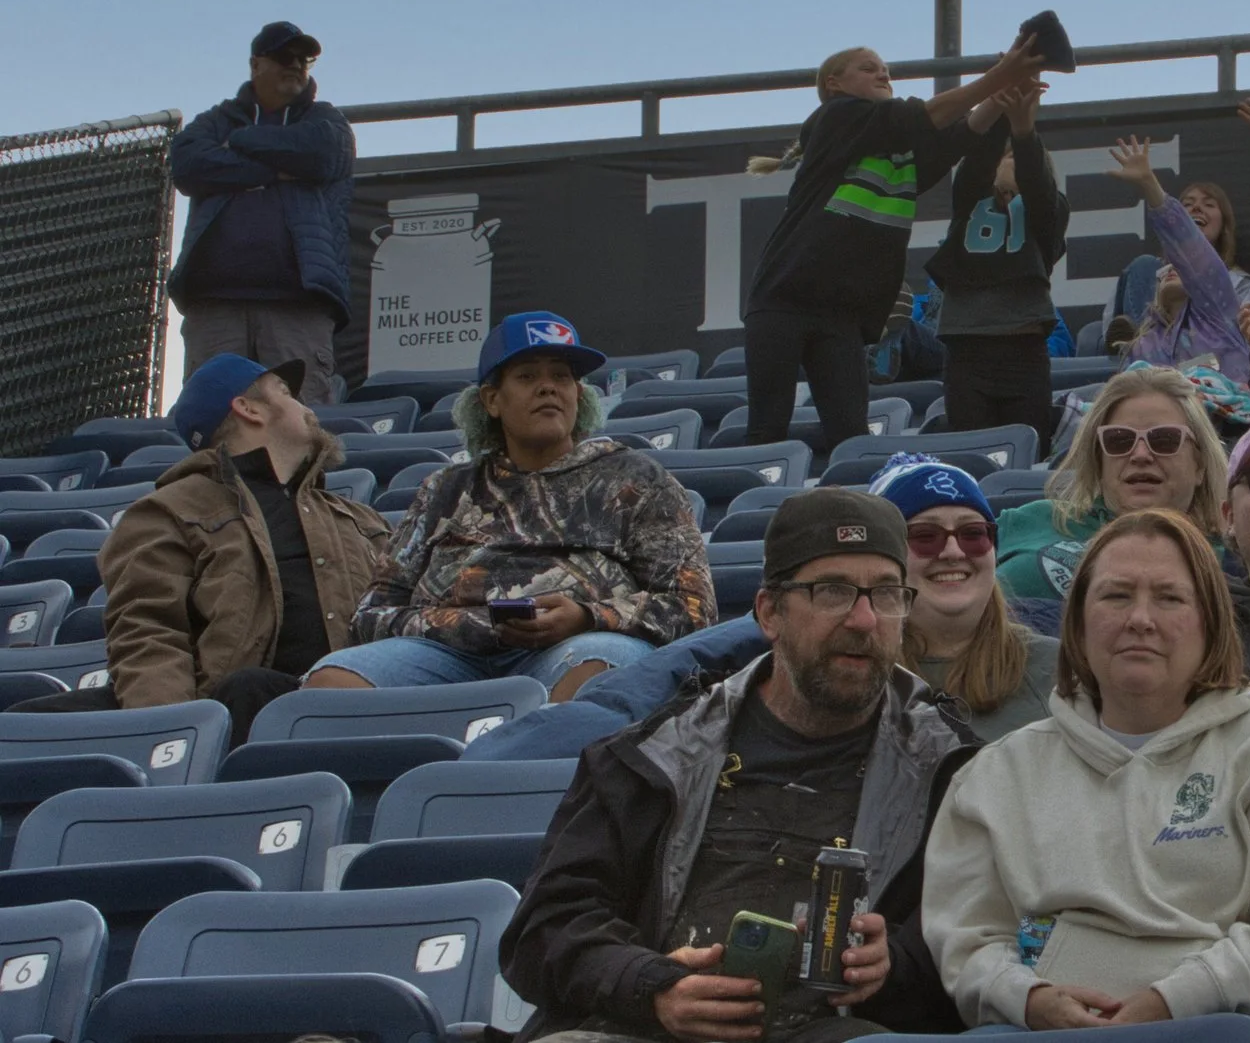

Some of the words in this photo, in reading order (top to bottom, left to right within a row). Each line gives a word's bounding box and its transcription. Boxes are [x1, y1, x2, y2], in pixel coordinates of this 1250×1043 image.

[402, 221, 428, 232] EST.
[432, 218, 465, 230] 2020
[377, 295, 411, 311] THE
[377, 312, 419, 329] MILK
[424, 308, 483, 327] HOUSE
[398, 330, 454, 347] COFFEE
[459, 328, 482, 343] CO.
[17, 615, 28, 630] 3
[88, 674, 98, 687] 4
[161, 744, 174, 763] 5
[273, 826, 287, 848] 6
[1152, 825, 1225, 846] Mariners
[829, 893, 839, 913] ALE
[824, 915, 837, 949] AMBER
[434, 941, 450, 966] 7
[16, 960, 31, 984] 6
